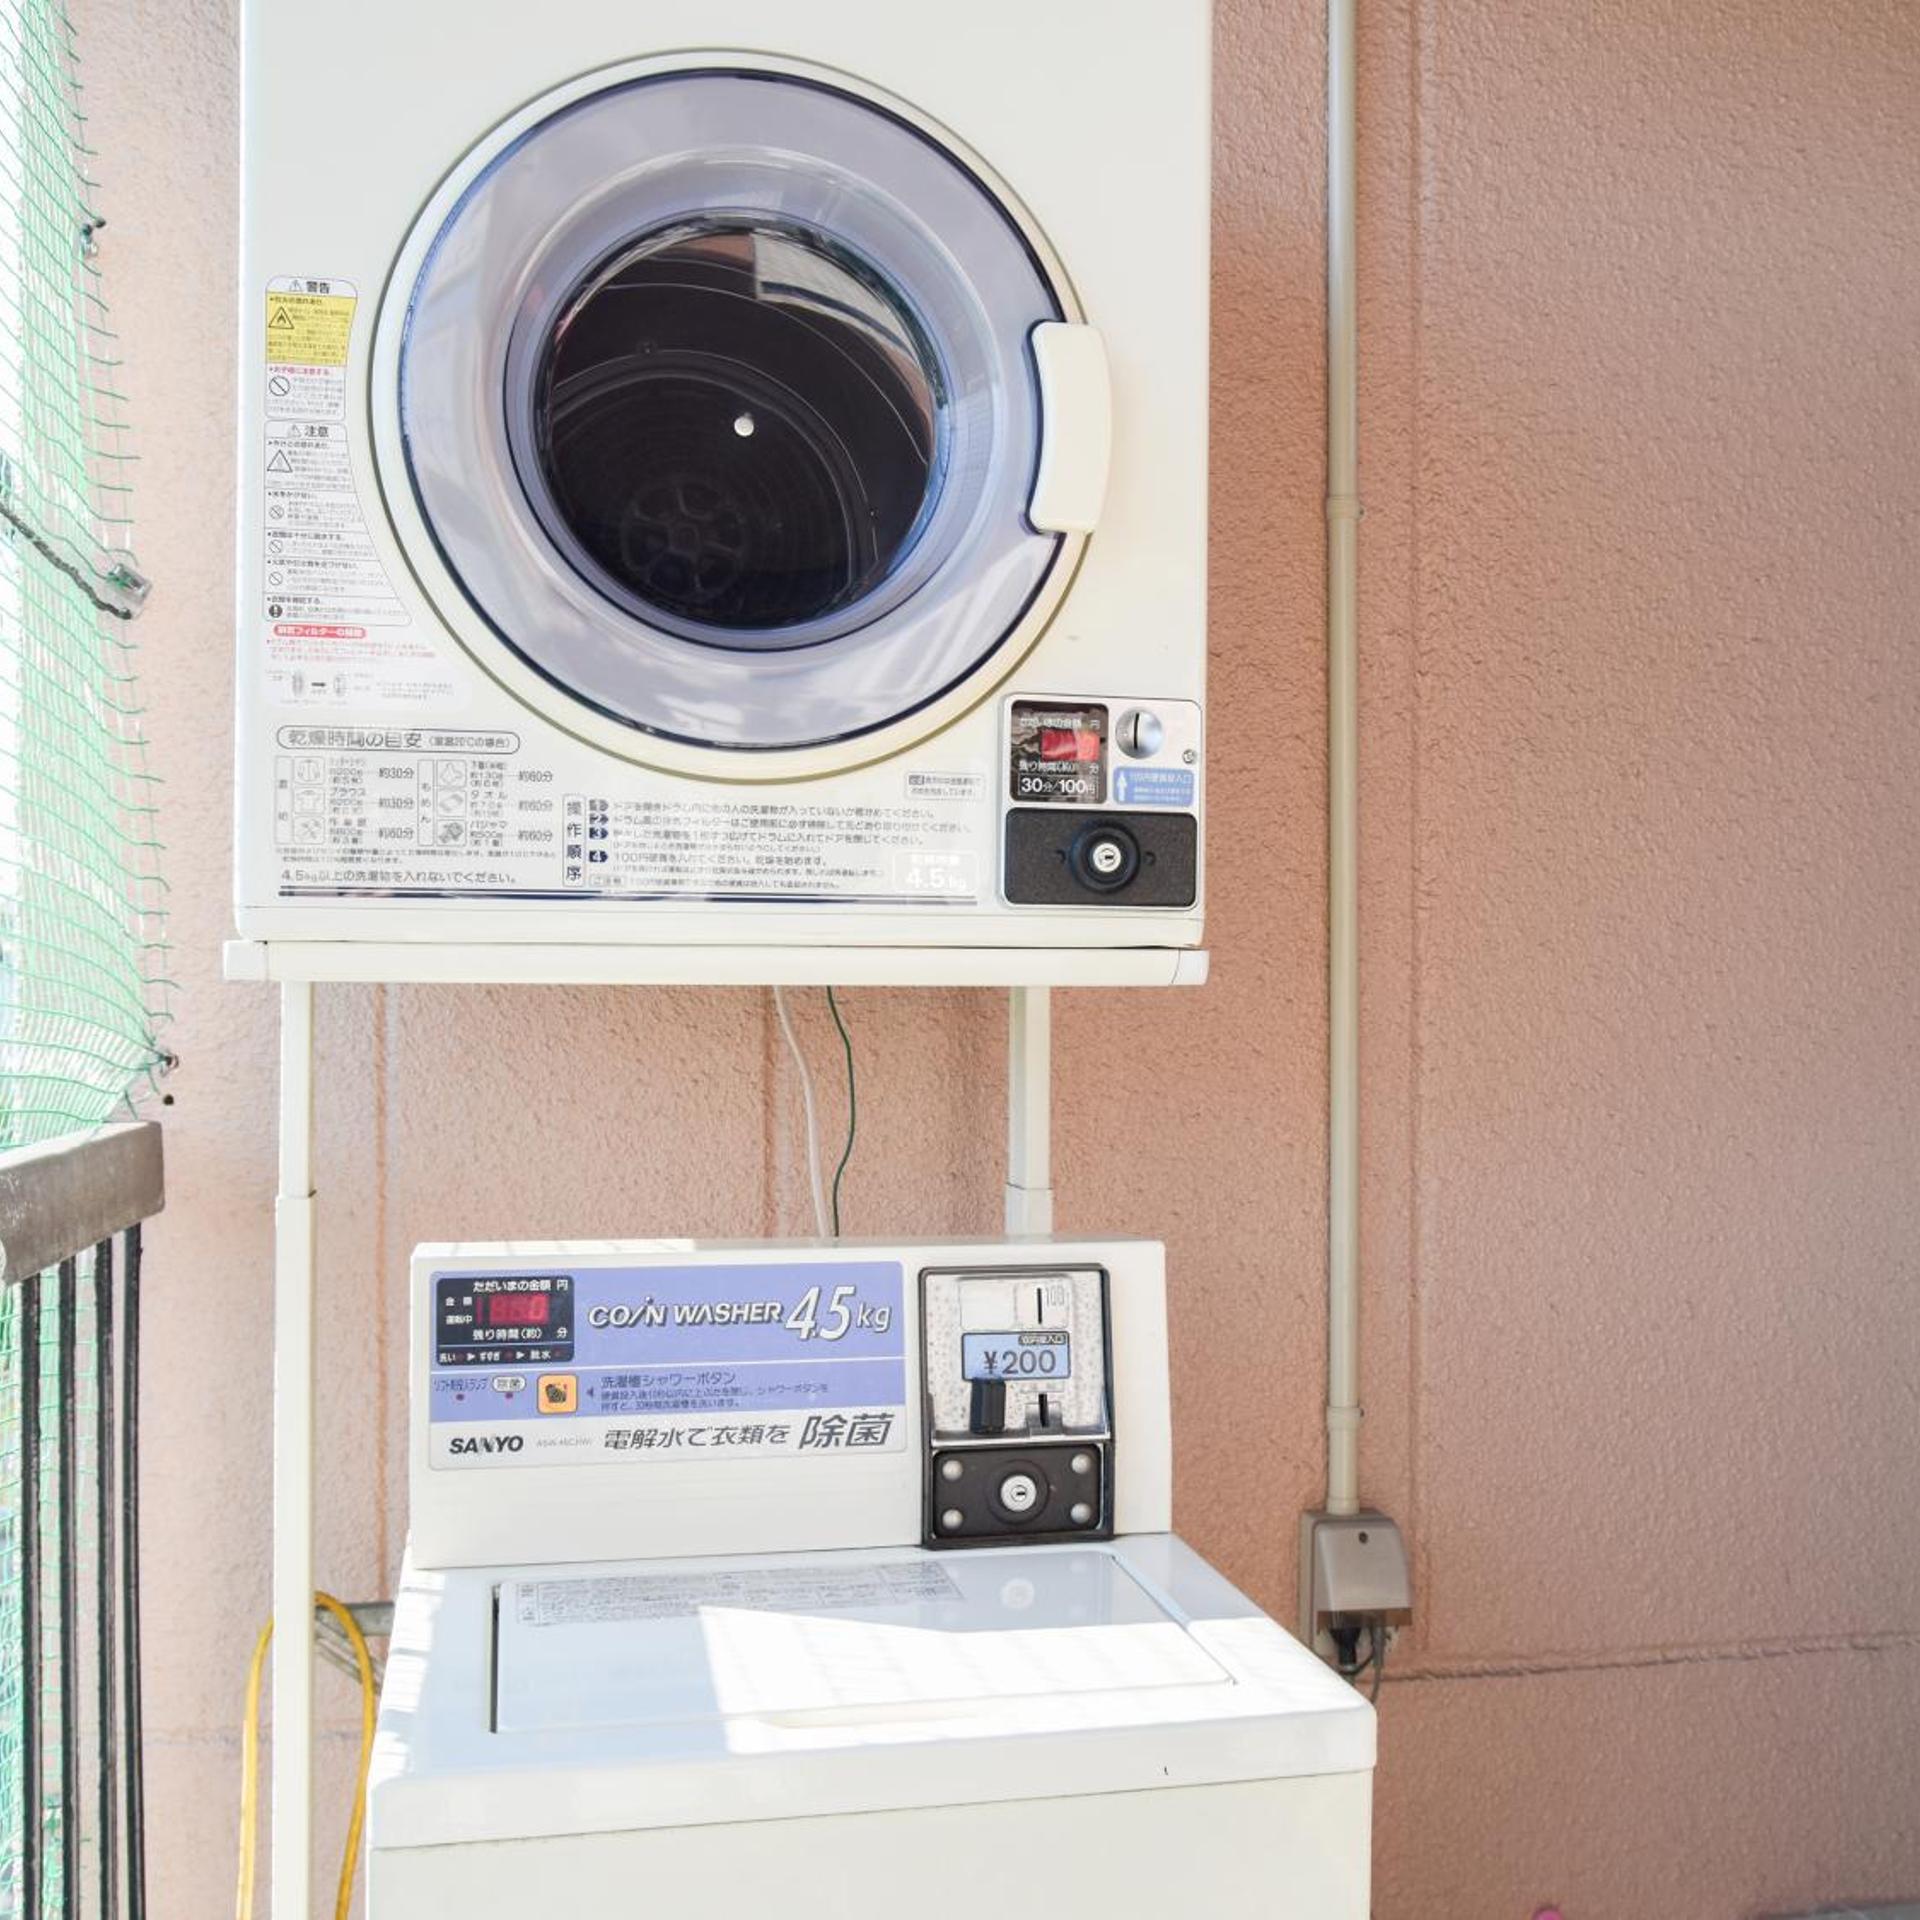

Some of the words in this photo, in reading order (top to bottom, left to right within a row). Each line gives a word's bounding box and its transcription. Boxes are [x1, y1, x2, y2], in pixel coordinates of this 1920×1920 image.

[305, 425, 329, 438] 注意
[288, 730, 422, 748] 乾燥時間の目安
[473, 1280, 551, 1293] ただいまの金額
[556, 1280, 568, 1291] 円
[674, 1301, 784, 1325] WASHER
[556, 1328, 568, 1339] 分
[984, 1350, 1057, 1375] ¥200
[604, 1424, 790, 1450] 電解水で衣類を
[799, 1413, 895, 1450] 除菌
[449, 1436, 524, 1454] SANYO
